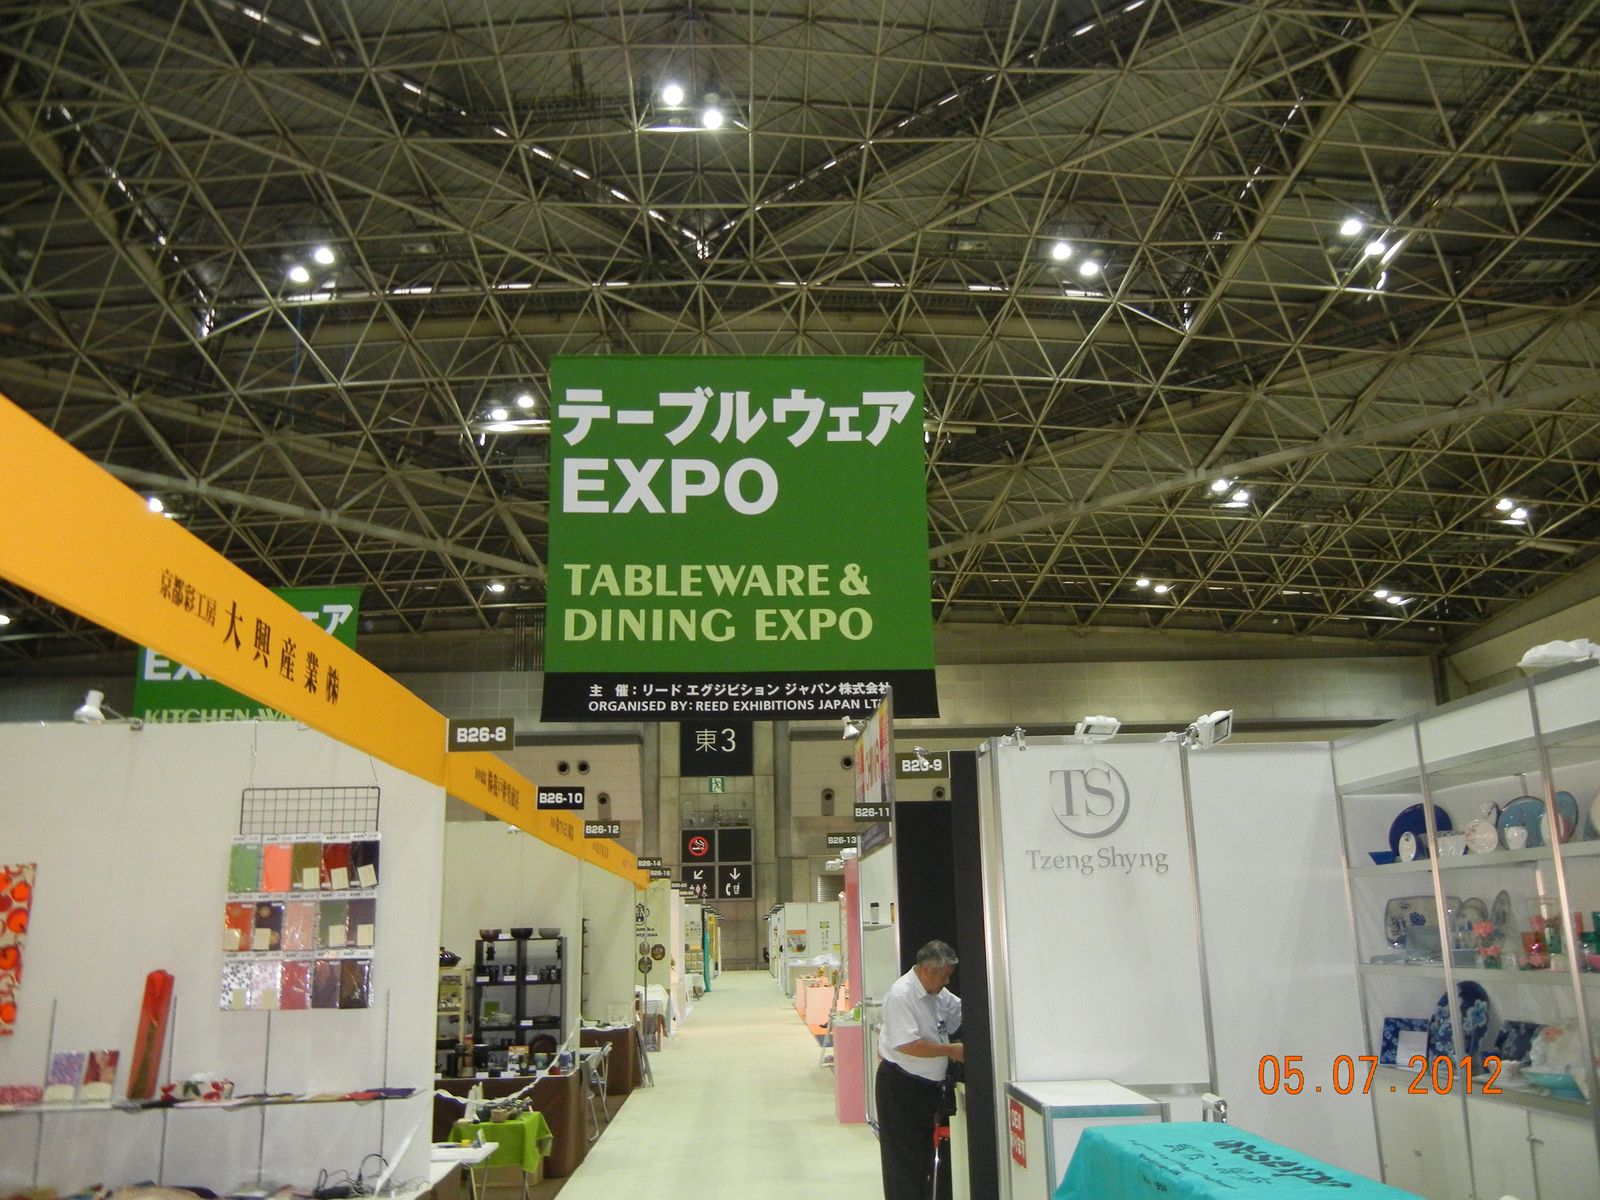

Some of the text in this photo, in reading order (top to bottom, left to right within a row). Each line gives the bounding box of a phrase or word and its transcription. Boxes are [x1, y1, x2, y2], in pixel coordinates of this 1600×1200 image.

[558, 386, 916, 448] テーブルウェア
[562, 457, 779, 516] EXPO
[563, 562, 872, 597] TABLEWARE &
[563, 607, 874, 642] DINING EXPO
[588, 700, 666, 711] ORGANISED
[696, 700, 728, 711] REED
[733, 699, 814, 711] EXHIBITIONS
[818, 699, 860, 710] JAPAN
[145, 708, 250, 723] KITCHEN
[456, 727, 507, 743] B26-8
[539, 792, 583, 804] B26-10
[1049, 767, 1115, 817] TS
[855, 807, 890, 817] B26-11
[585, 825, 619, 834] B26-12
[827, 837, 857, 845] B26-13
[1025, 846, 1169, 875] Tzeng Shyng
